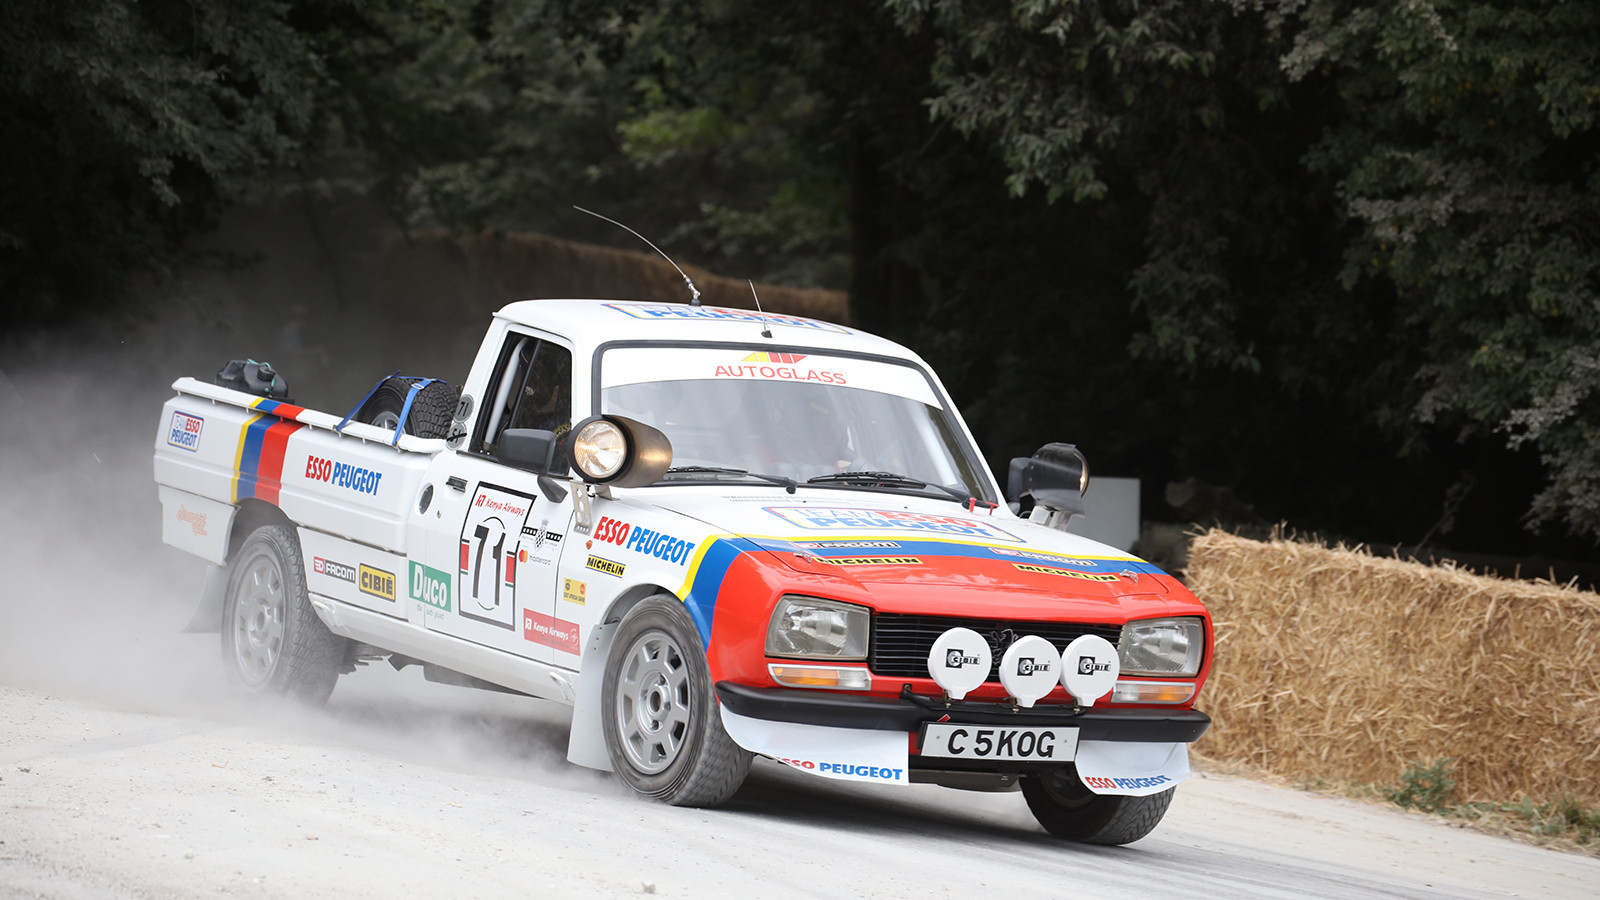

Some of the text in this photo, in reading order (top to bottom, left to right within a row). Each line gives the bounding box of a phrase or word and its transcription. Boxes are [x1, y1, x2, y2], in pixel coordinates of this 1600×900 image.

[714, 365, 847, 385] AUTOGLASS
[457, 401, 469, 417] 71
[185, 418, 201, 434] ESSO
[170, 428, 198, 448] PEUGEOT
[305, 454, 382, 496] ESSO PEUGEOT
[485, 498, 526, 517] Kenya Airways
[805, 517, 995, 538] PEUGEOT
[873, 511, 979, 528] ESSO
[593, 515, 696, 567] ESSO PEUGEOT
[472, 524, 507, 606] 71
[586, 557, 625, 576] MICHELIN
[815, 557, 919, 565] MICHELIN
[325, 562, 356, 581] FACOM
[1017, 564, 1118, 581] MICHELIN
[533, 621, 570, 641] Kenya Airways
[819, 762, 903, 780] PEUGEOT
[1084, 774, 1172, 790] ESSO PEUGEOT
